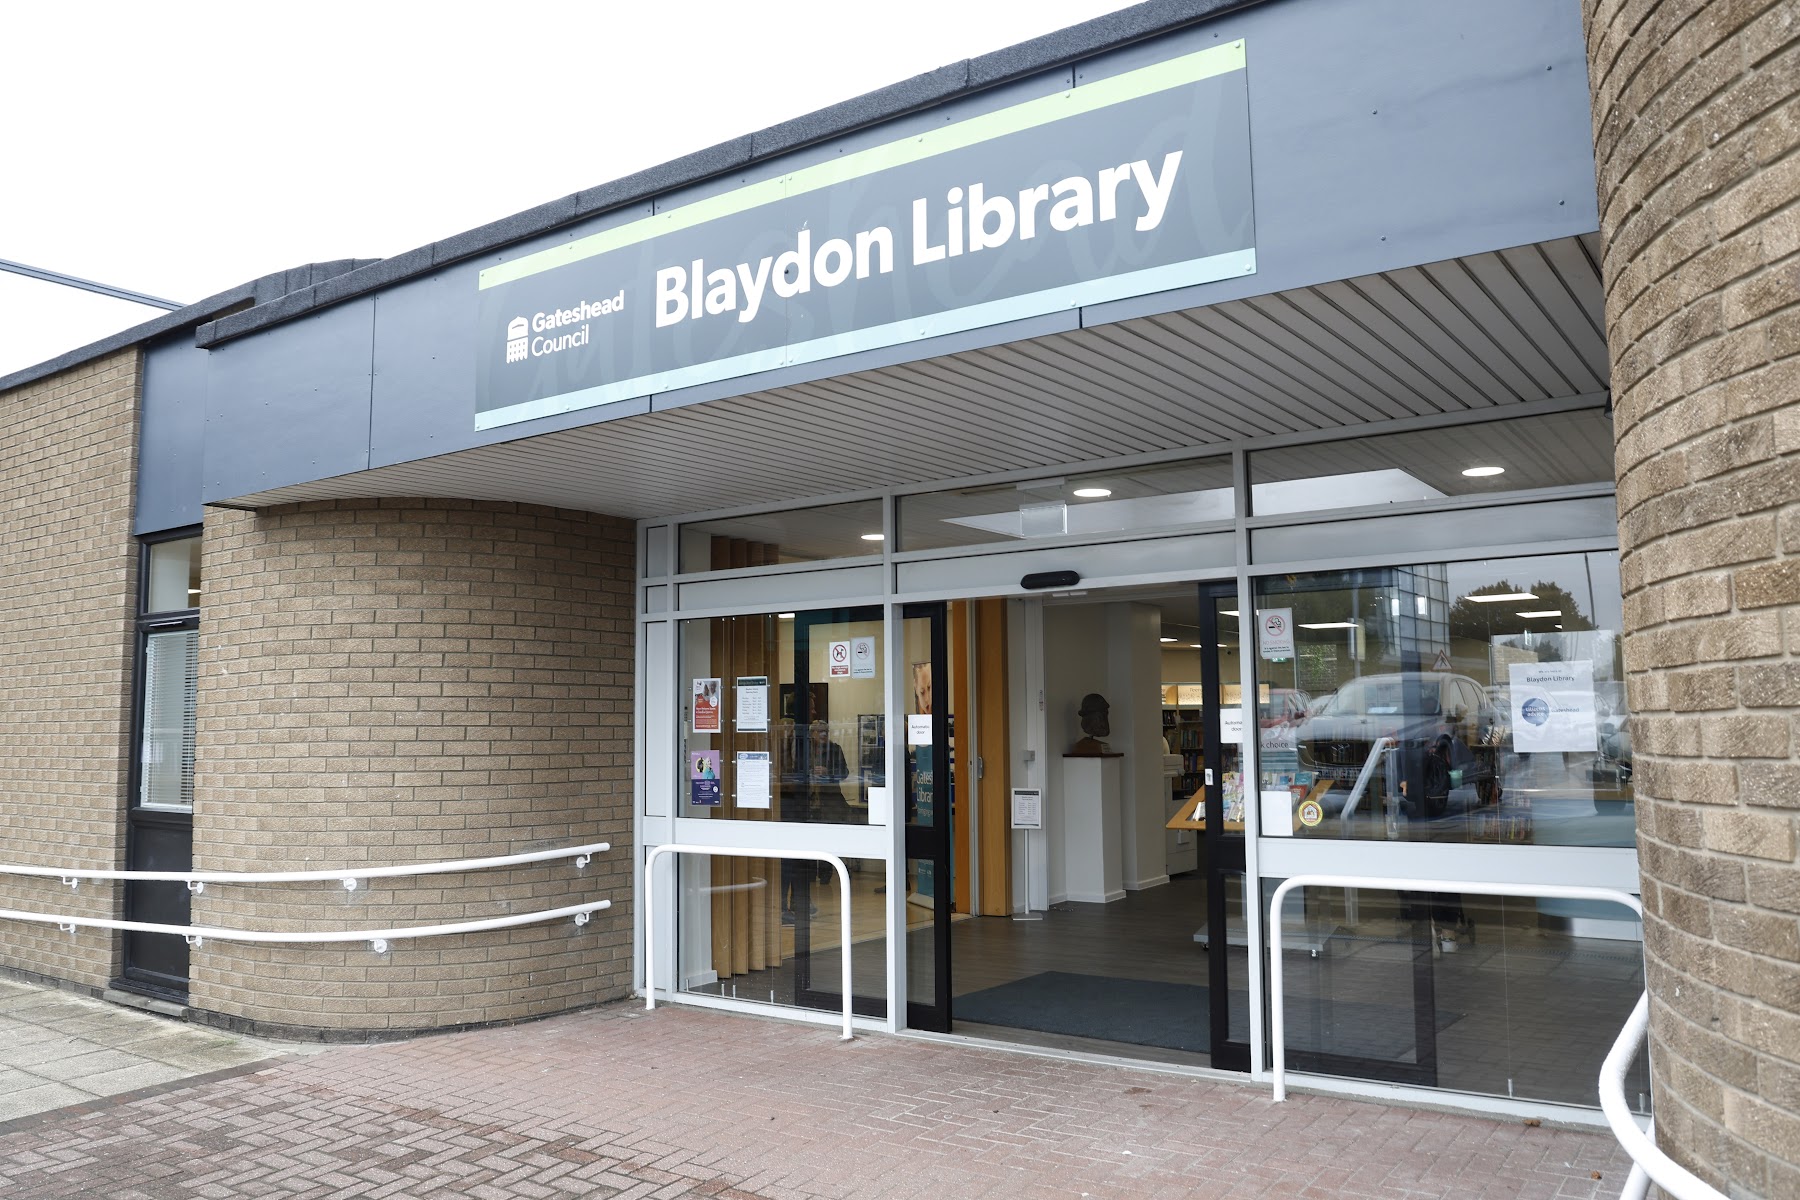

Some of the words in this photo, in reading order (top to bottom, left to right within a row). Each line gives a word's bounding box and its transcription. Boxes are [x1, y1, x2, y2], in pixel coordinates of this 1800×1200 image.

[655, 222, 894, 329] Blaydon
[911, 150, 1183, 266] Library
[531, 289, 625, 333] Gateshead
[531, 323, 590, 357] Council
